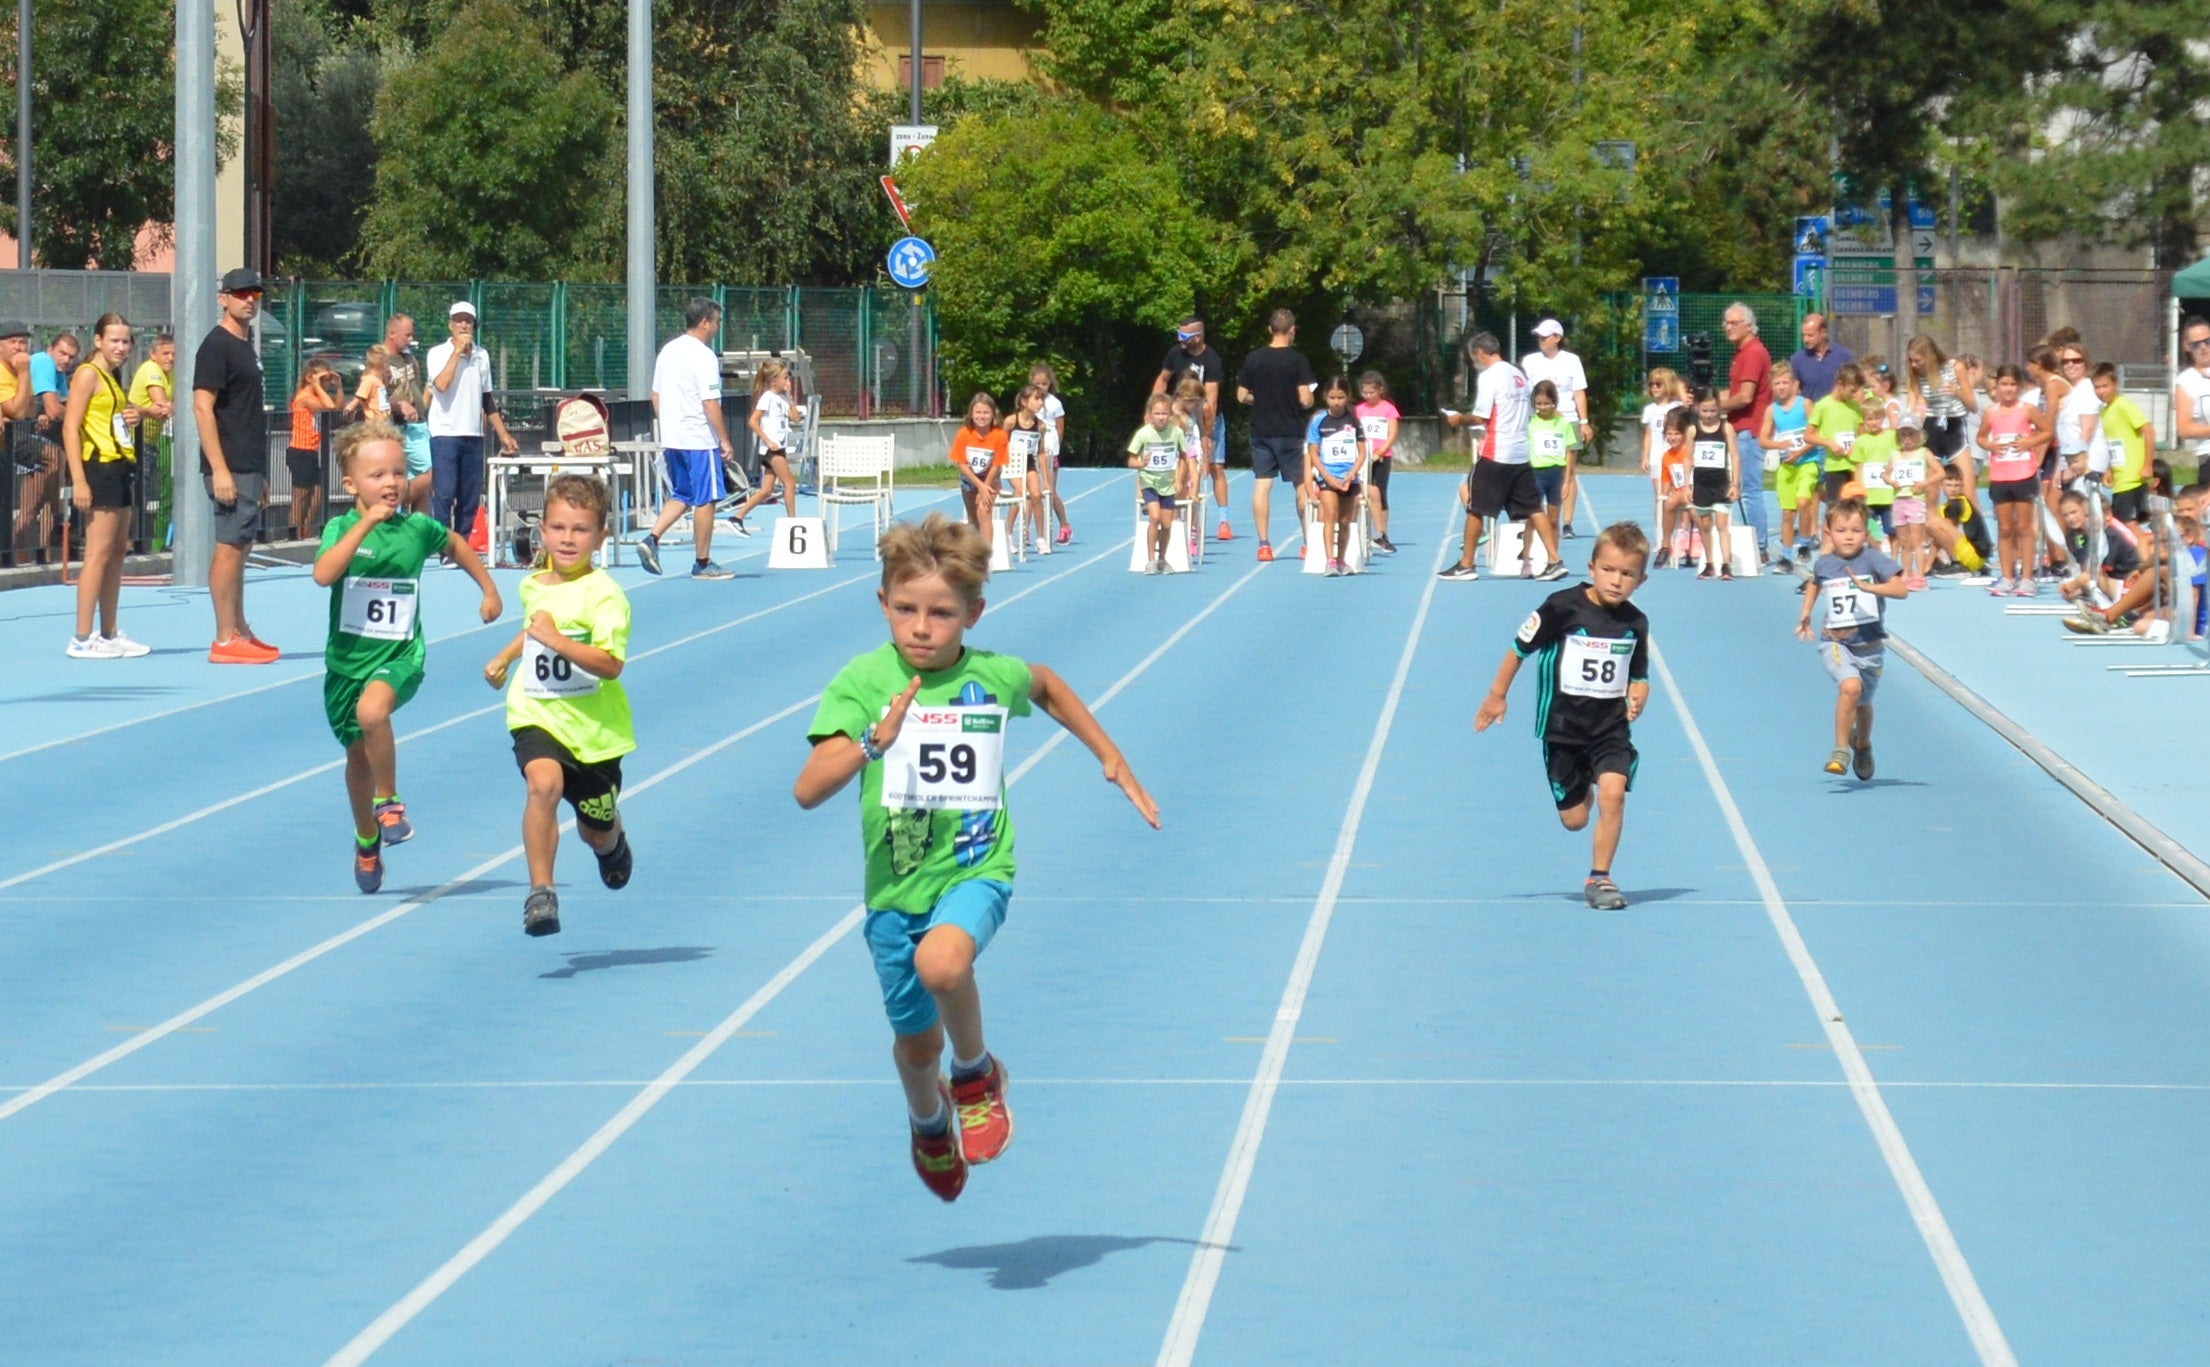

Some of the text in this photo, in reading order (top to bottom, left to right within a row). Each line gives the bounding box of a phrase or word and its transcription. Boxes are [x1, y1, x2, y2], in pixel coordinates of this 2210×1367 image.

[971, 456, 987, 468] 66
[1152, 455, 1168, 466] 65
[1332, 447, 1347, 456] 64
[789, 525, 807, 555] 6
[367, 599, 397, 624] 61
[1832, 594, 1857, 615] 57
[535, 654, 572, 681] 60
[1581, 658, 1616, 684] 58
[919, 743, 977, 784] 59
